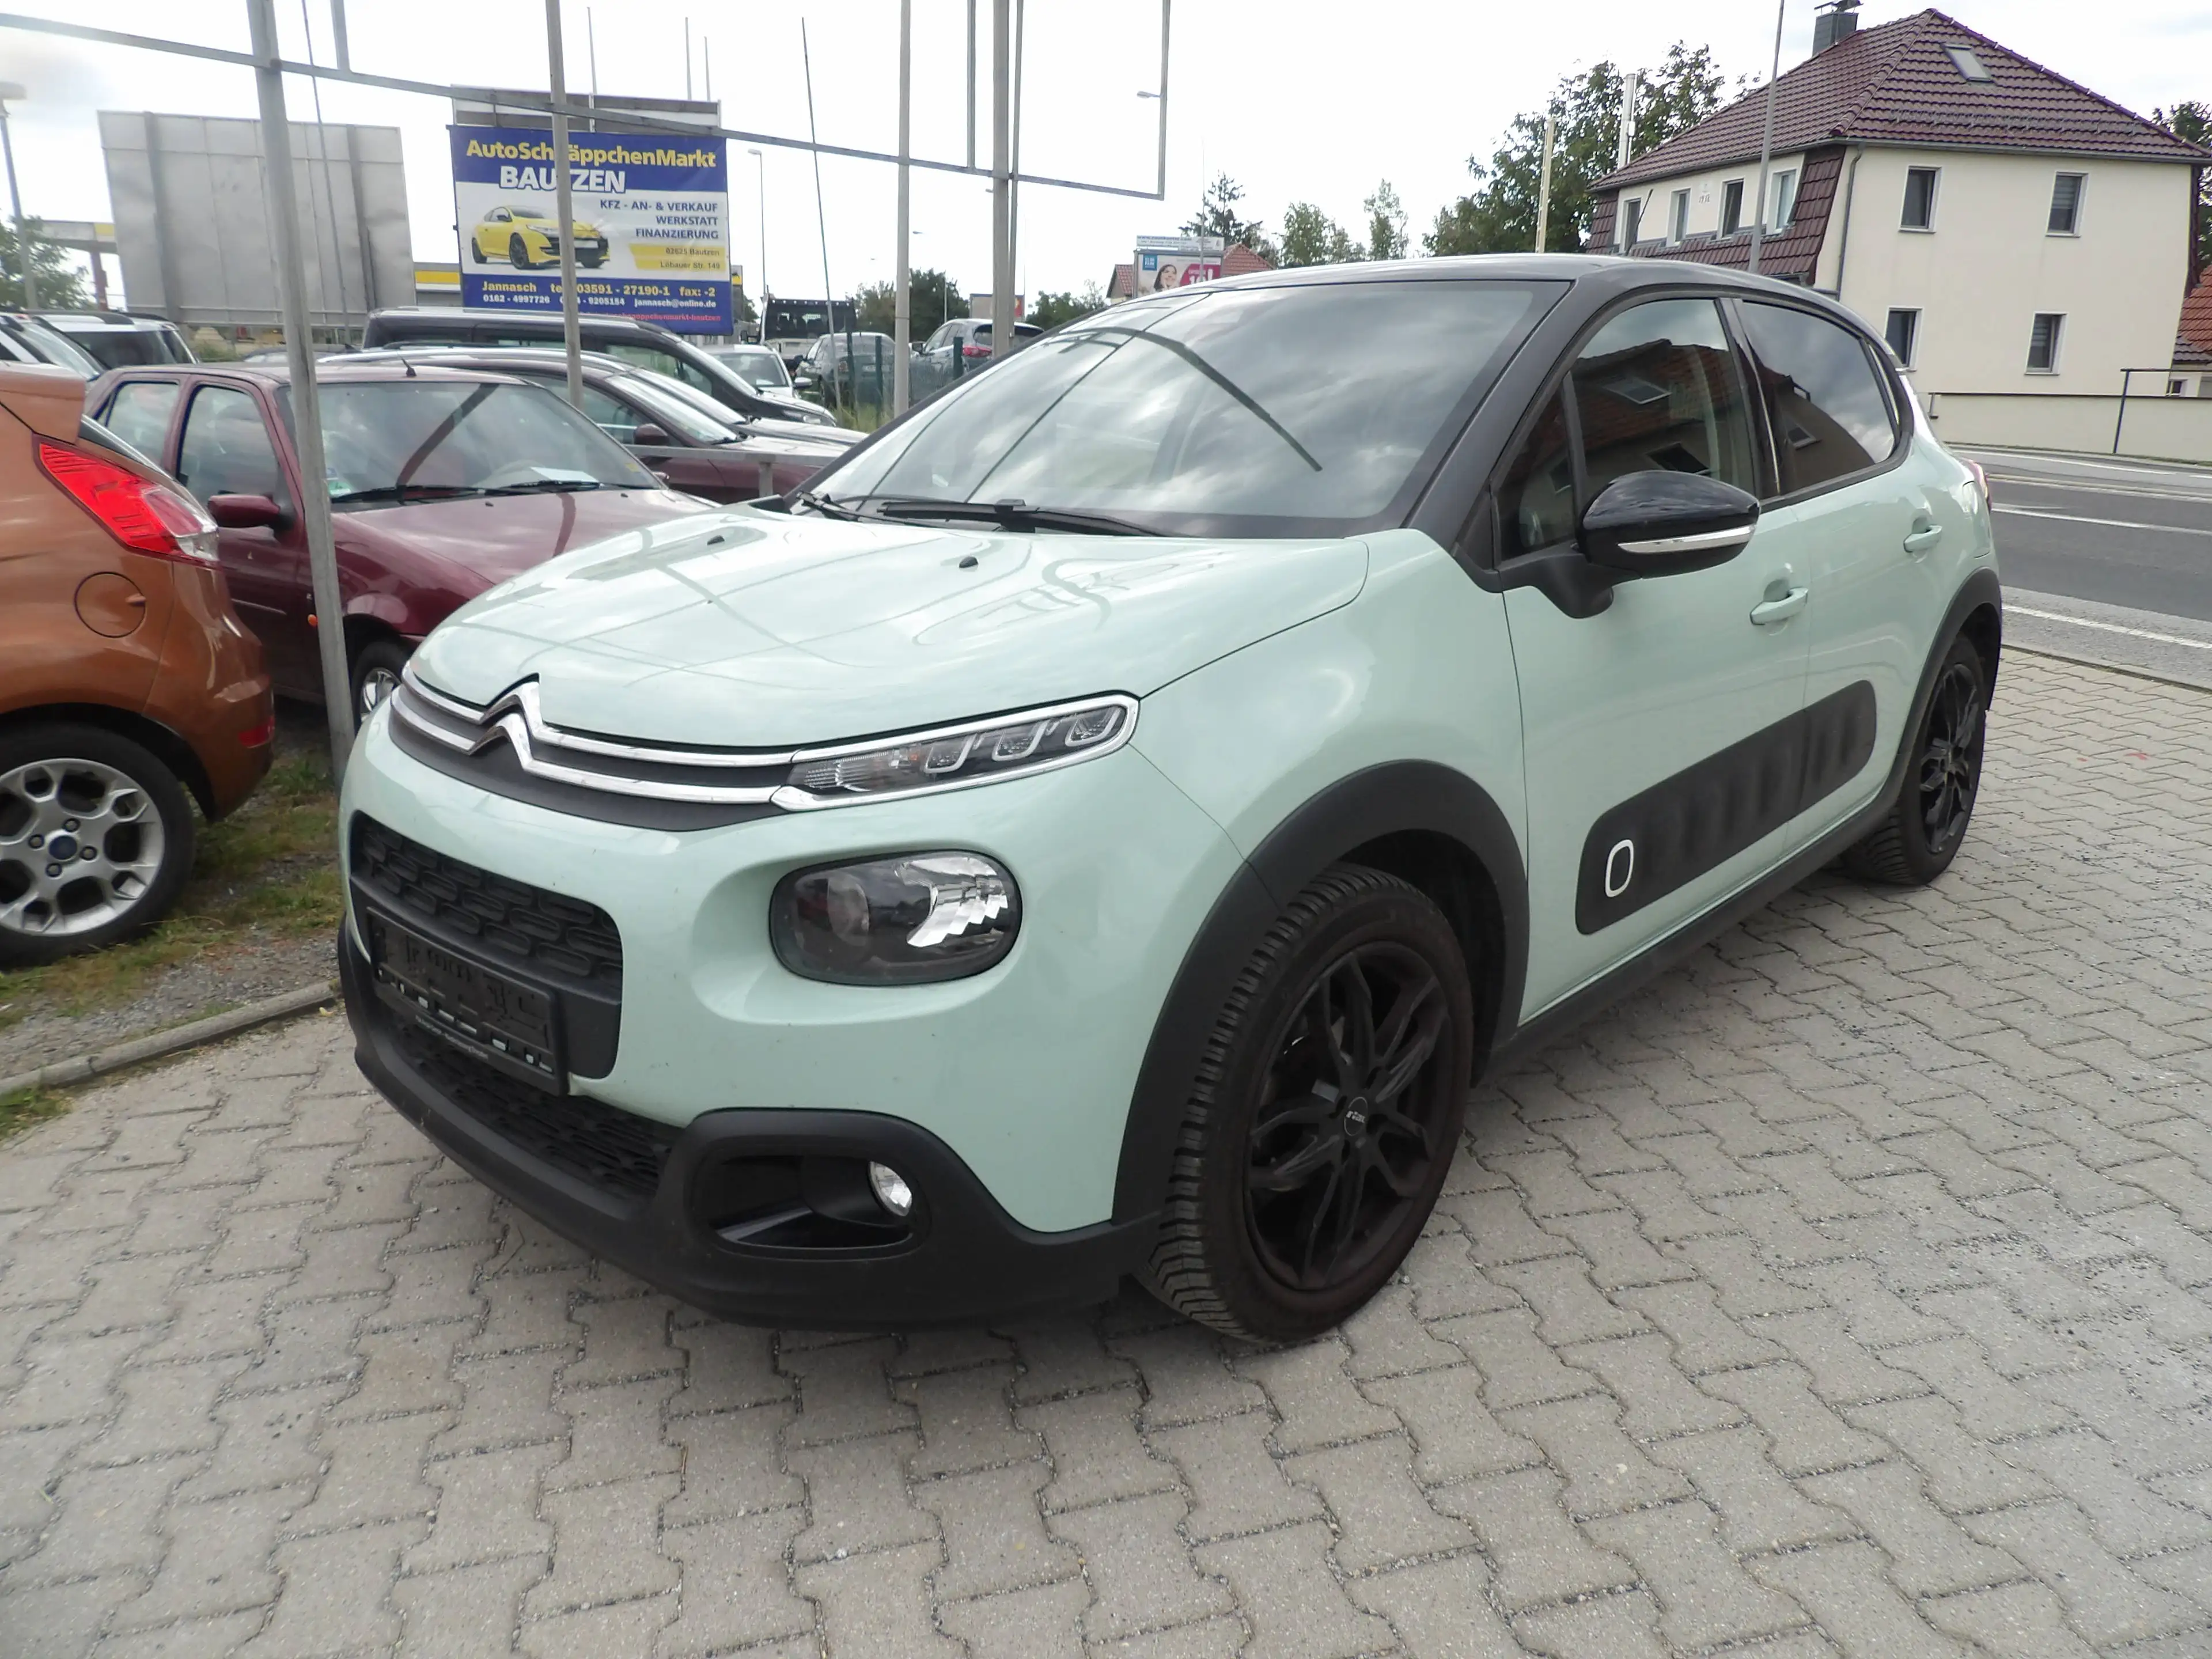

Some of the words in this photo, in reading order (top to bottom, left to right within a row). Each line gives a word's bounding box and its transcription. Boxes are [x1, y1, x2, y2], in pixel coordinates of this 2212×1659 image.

[467, 139, 716, 168] AutoSchäppchenMarkt
[499, 165, 626, 193] BAUZEN
[600, 200, 620, 210] KFZ
[631, 200, 652, 210] AN-
[656, 201, 664, 210] &
[666, 202, 718, 212] VERKAUF
[656, 215, 718, 226] WERKSTATT
[636, 229, 719, 239] FINANZIERUNG
[482, 281, 537, 292] Jannasch
[577, 283, 612, 294] 03591
[623, 285, 670, 296] 27190-1
[679, 287, 701, 297] fax:
[704, 287, 715, 297] -2
[483, 294, 505, 302] 0162
[634, 298, 717, 308] jannasch@online.de
